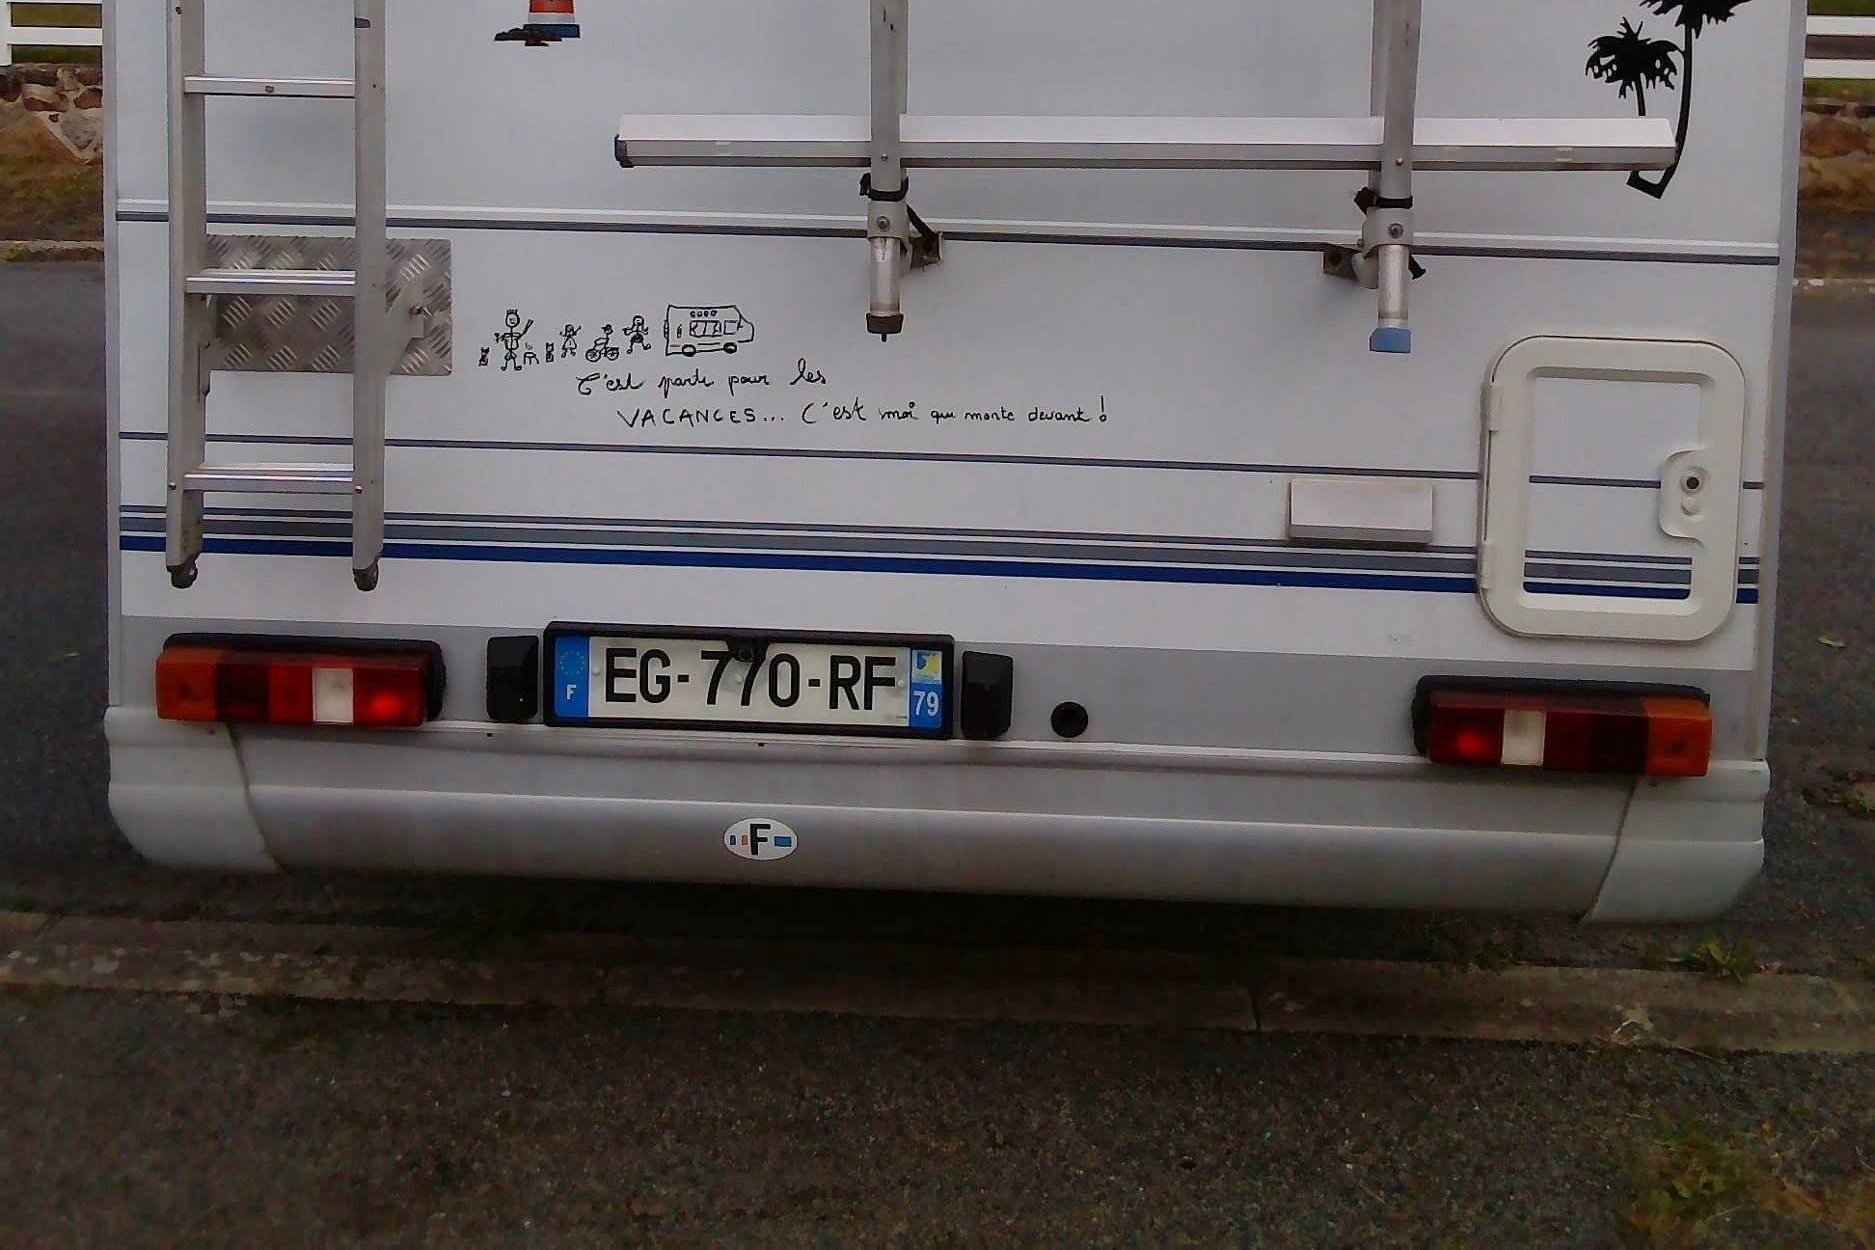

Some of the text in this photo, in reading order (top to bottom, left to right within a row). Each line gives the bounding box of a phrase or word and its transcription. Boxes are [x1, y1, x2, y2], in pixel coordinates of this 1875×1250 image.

[728, 374, 770, 396] pour
[790, 358, 826, 385] les
[801, 397, 868, 424] C'est
[878, 401, 918, 421] moi
[931, 409, 956, 425] qui
[964, 407, 1015, 422] monte
[1027, 406, 1092, 423] devant
[566, 647, 939, 717] F EG-770-RF 79
[750, 823, 771, 855] F
